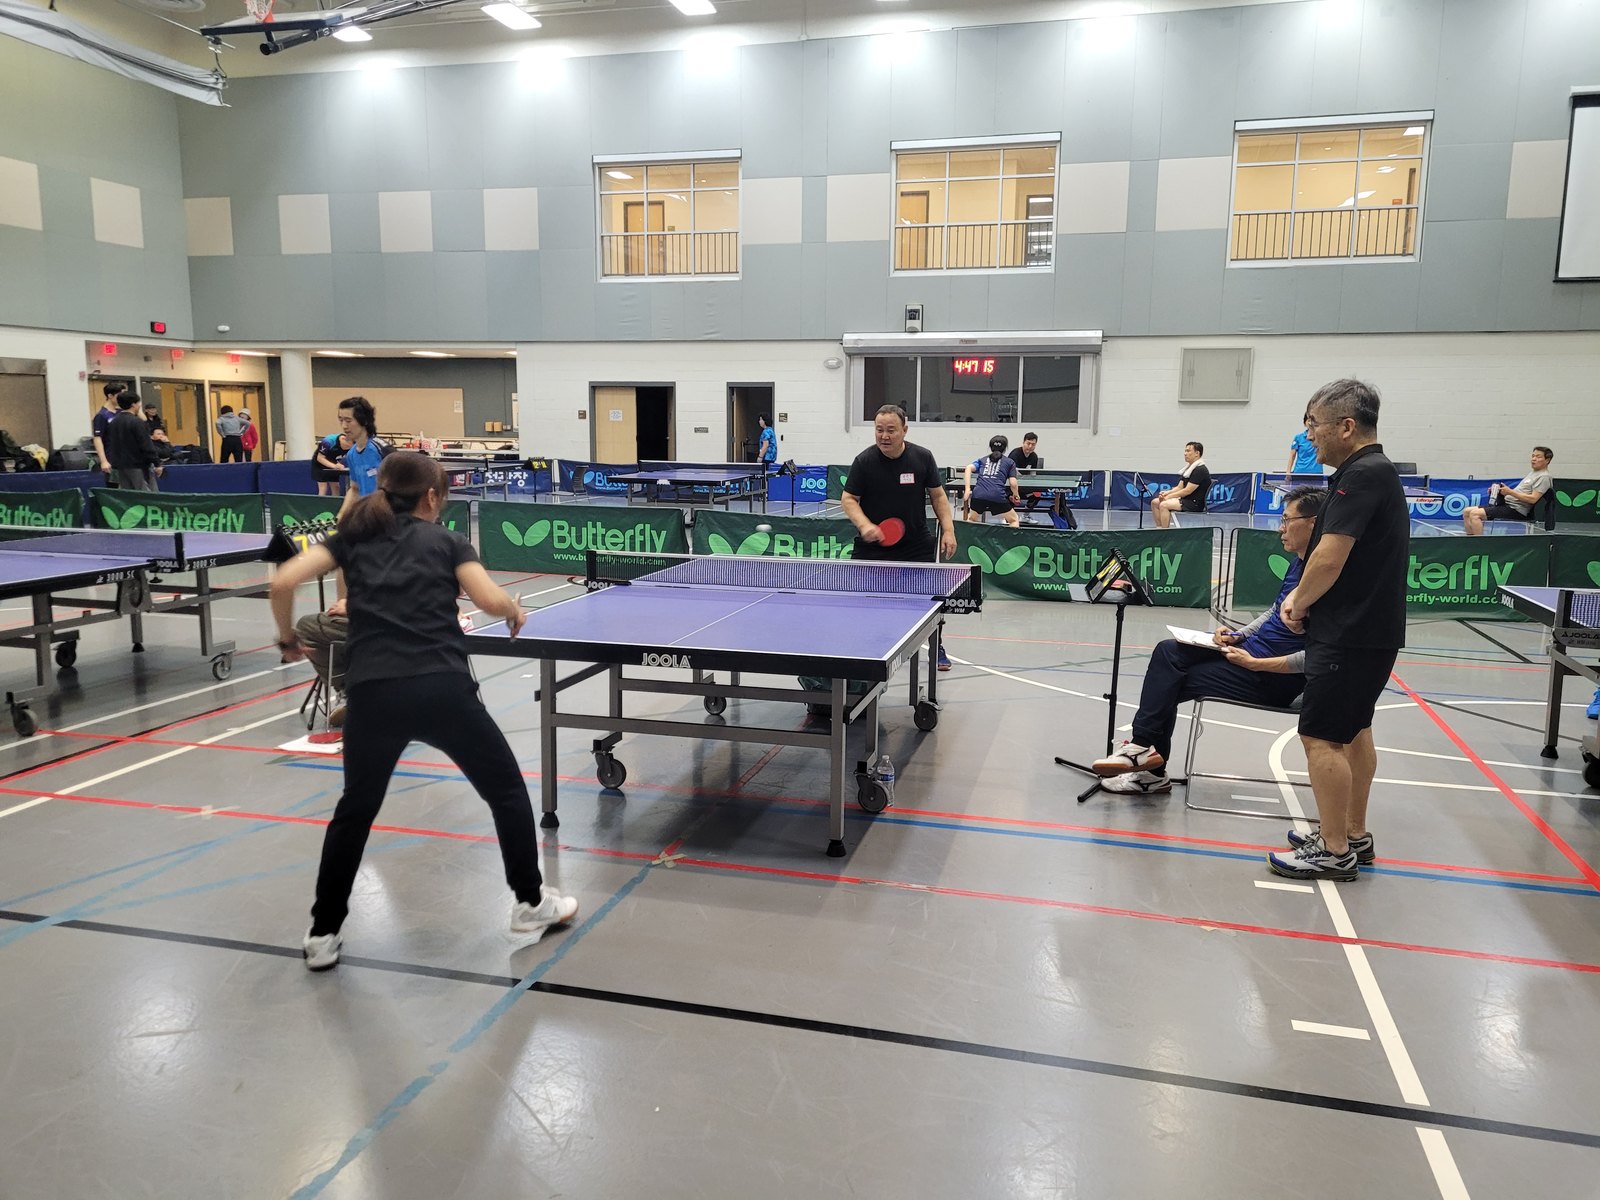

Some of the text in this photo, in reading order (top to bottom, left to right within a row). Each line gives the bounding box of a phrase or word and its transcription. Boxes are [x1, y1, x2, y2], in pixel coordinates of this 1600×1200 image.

[954, 359, 995, 373] 4:47 15
[552, 520, 667, 553] Butterfly
[945, 599, 977, 608] JOOLA
[641, 652, 692, 669] JOOLA
